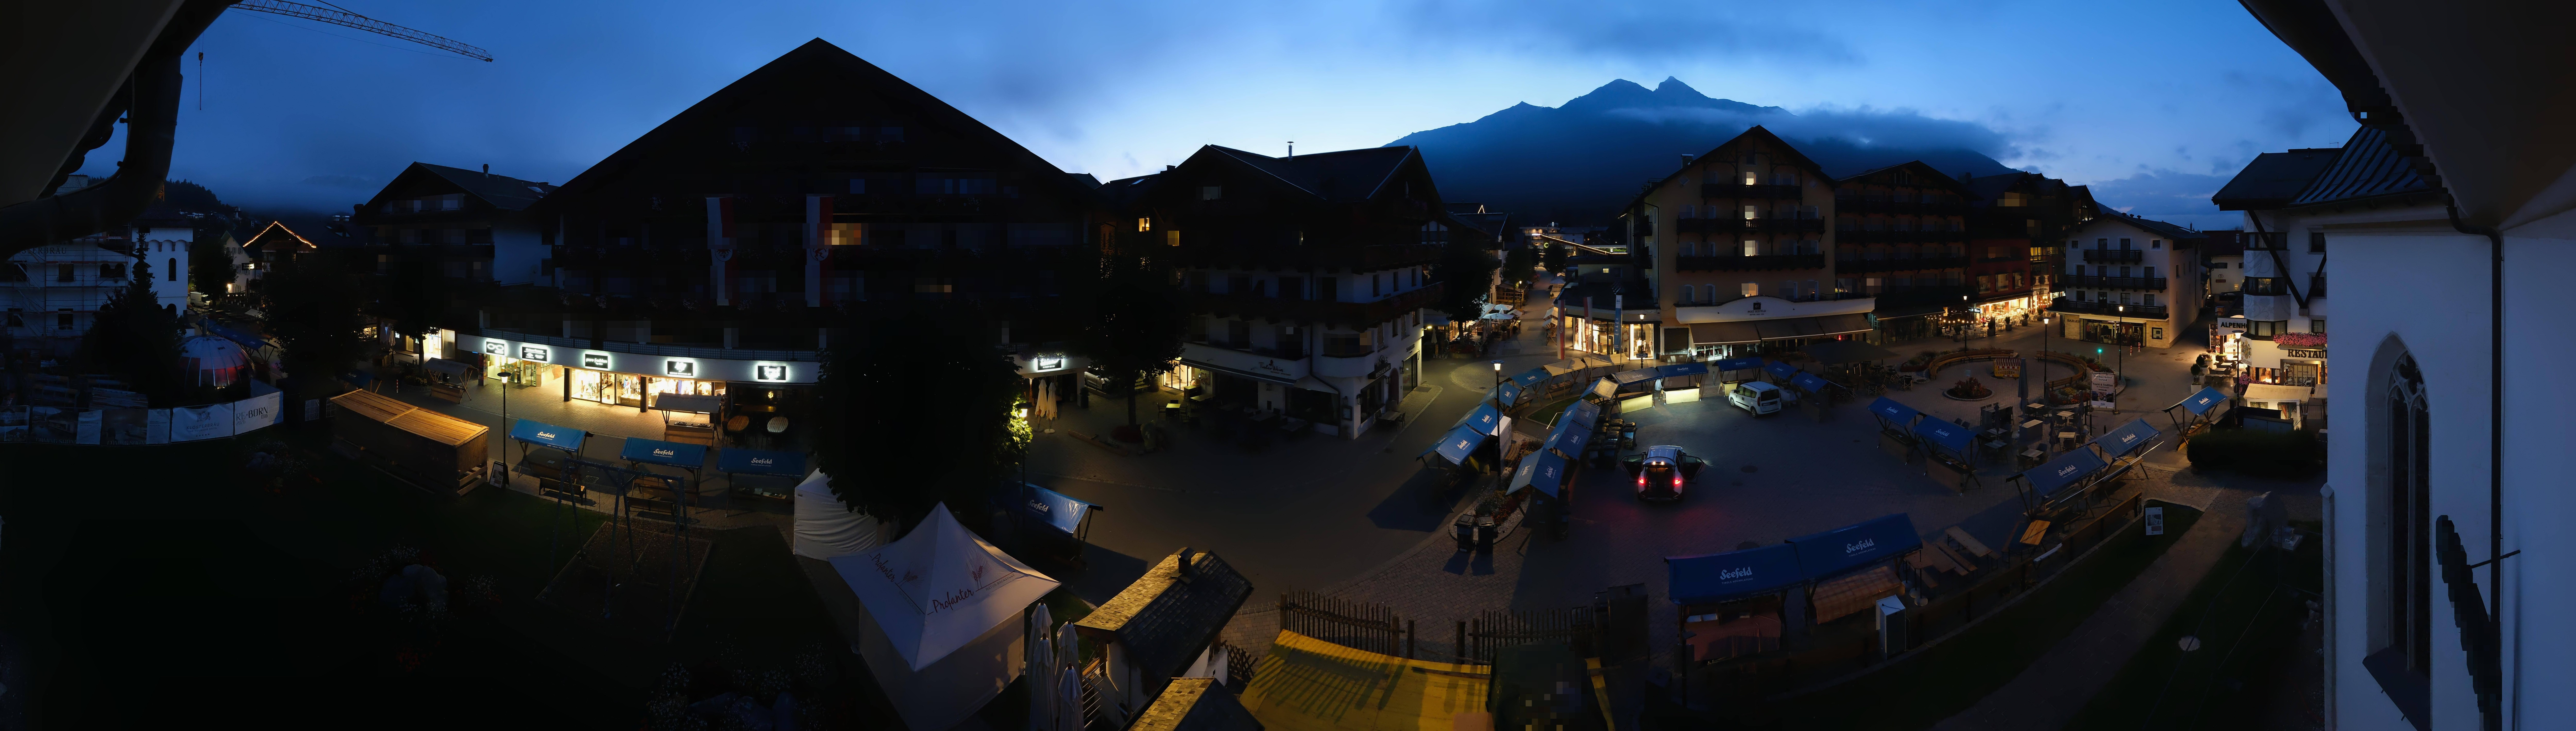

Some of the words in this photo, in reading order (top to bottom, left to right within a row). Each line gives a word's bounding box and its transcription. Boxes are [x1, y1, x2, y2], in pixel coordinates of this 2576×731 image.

[1376, 365, 1390, 378] RESTAURANT
[2122, 433, 2136, 442] Seefeld
[2058, 465, 2076, 476] Seefeld
[1028, 499, 1049, 512] Seefeld
[1846, 538, 1874, 553] Seefeld
[871, 553, 895, 582] Profanter
[1720, 566, 1752, 580] Seefeld
[986, 573, 1015, 591] NATUR-BACKSTUBE
[932, 589, 974, 613] Profanter
